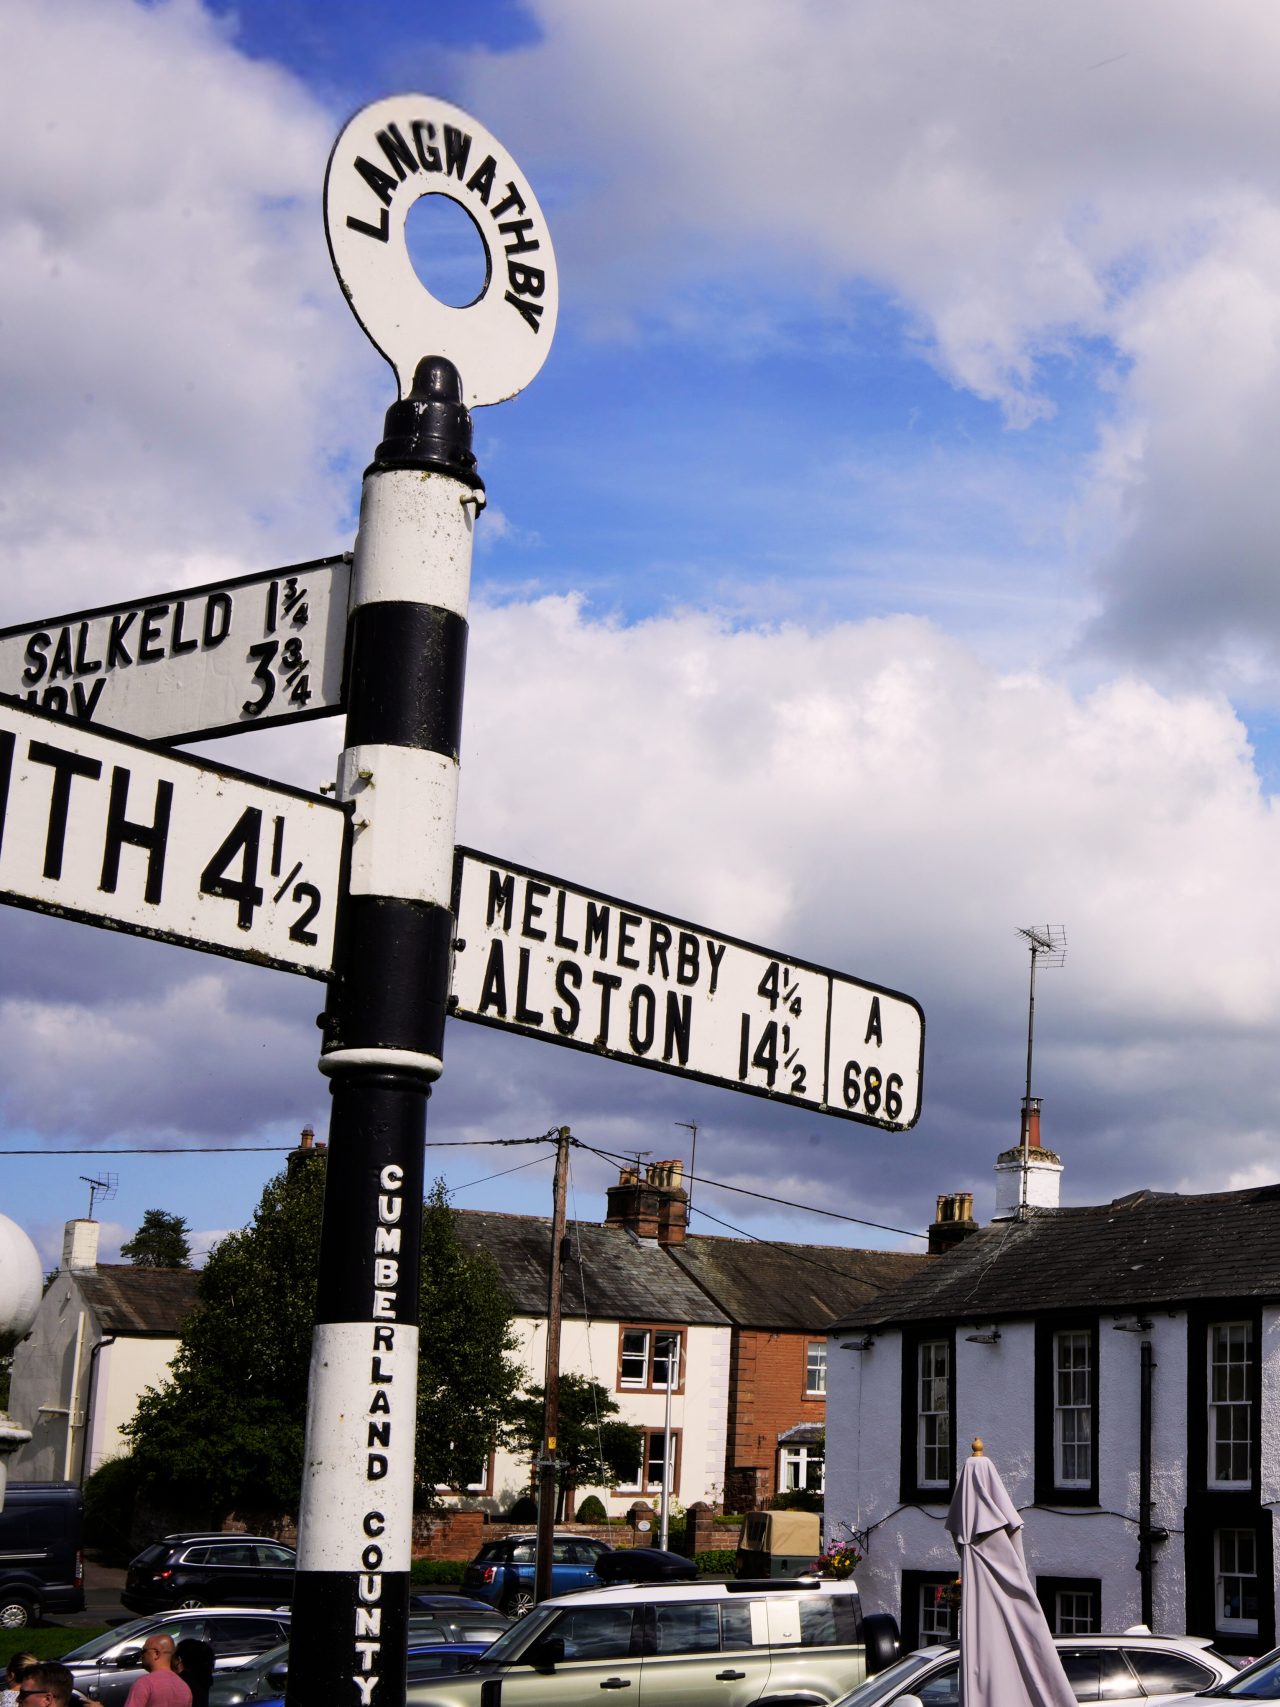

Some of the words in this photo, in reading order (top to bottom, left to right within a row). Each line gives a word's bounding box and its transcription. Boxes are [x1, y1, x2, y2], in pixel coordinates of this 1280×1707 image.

[346, 119, 545, 334] LANGWATHBY
[23, 592, 233, 683] SALKELD
[486, 870, 727, 993] MELMERBY
[479, 938, 693, 1065] ALSTON
[865, 996, 883, 1047] A
[842, 1060, 904, 1120] 686
[366, 1164, 403, 1482] CUMBERLAND
[352, 1511, 386, 1706] COUNTY
